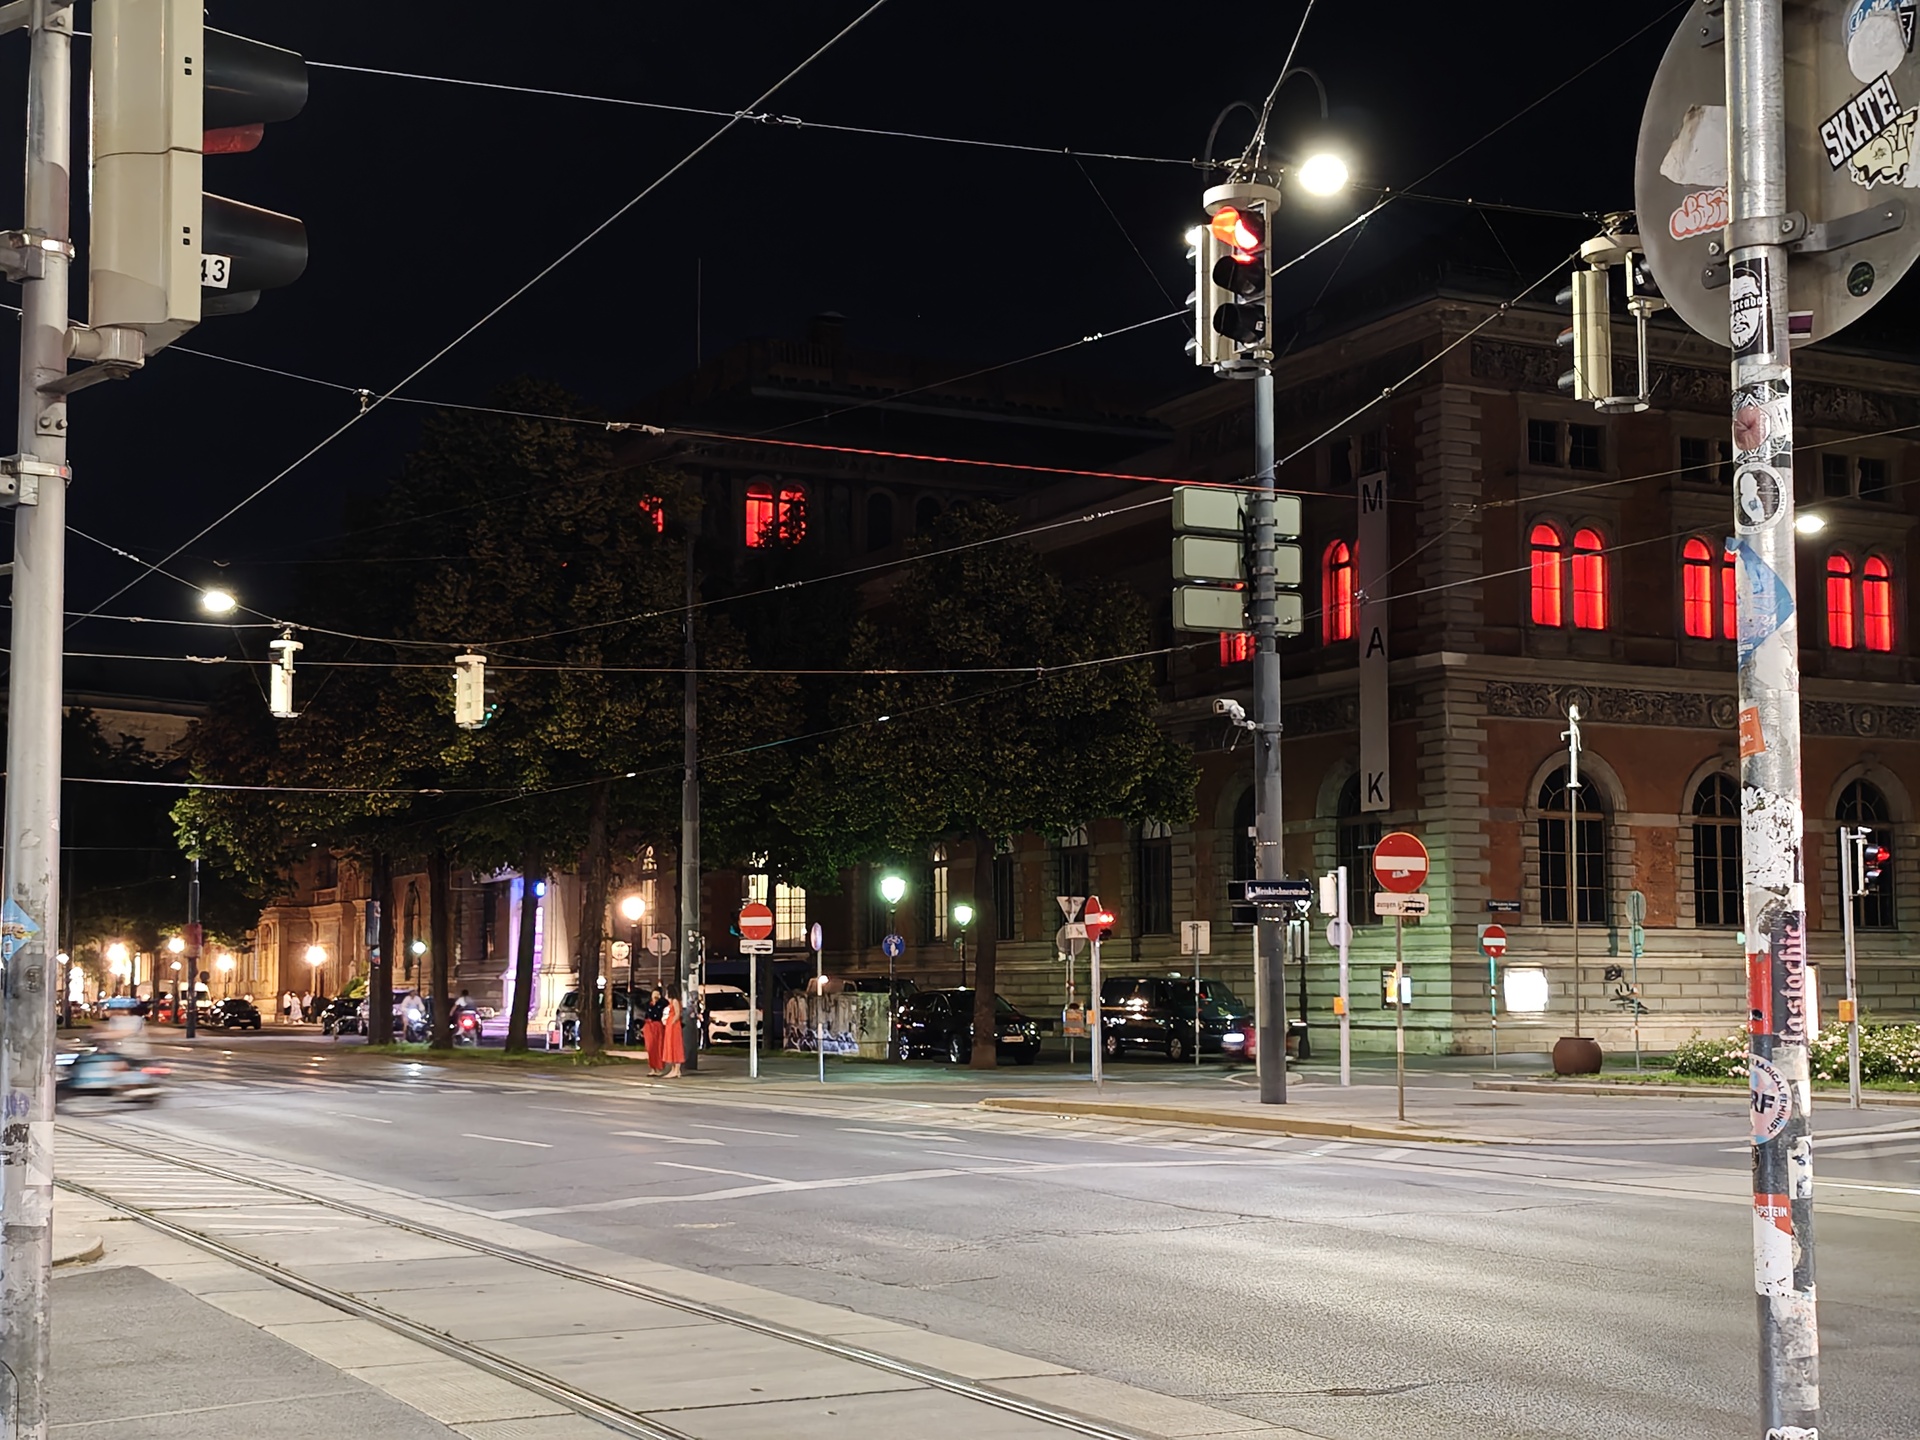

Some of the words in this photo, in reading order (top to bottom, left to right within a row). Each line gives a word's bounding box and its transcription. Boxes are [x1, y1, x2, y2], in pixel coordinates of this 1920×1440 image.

[1821, 74, 1901, 167] SKATE!
[1755, 1059, 1785, 1093] RADICAL
[1766, 1093, 1788, 1135] FEMINIST
